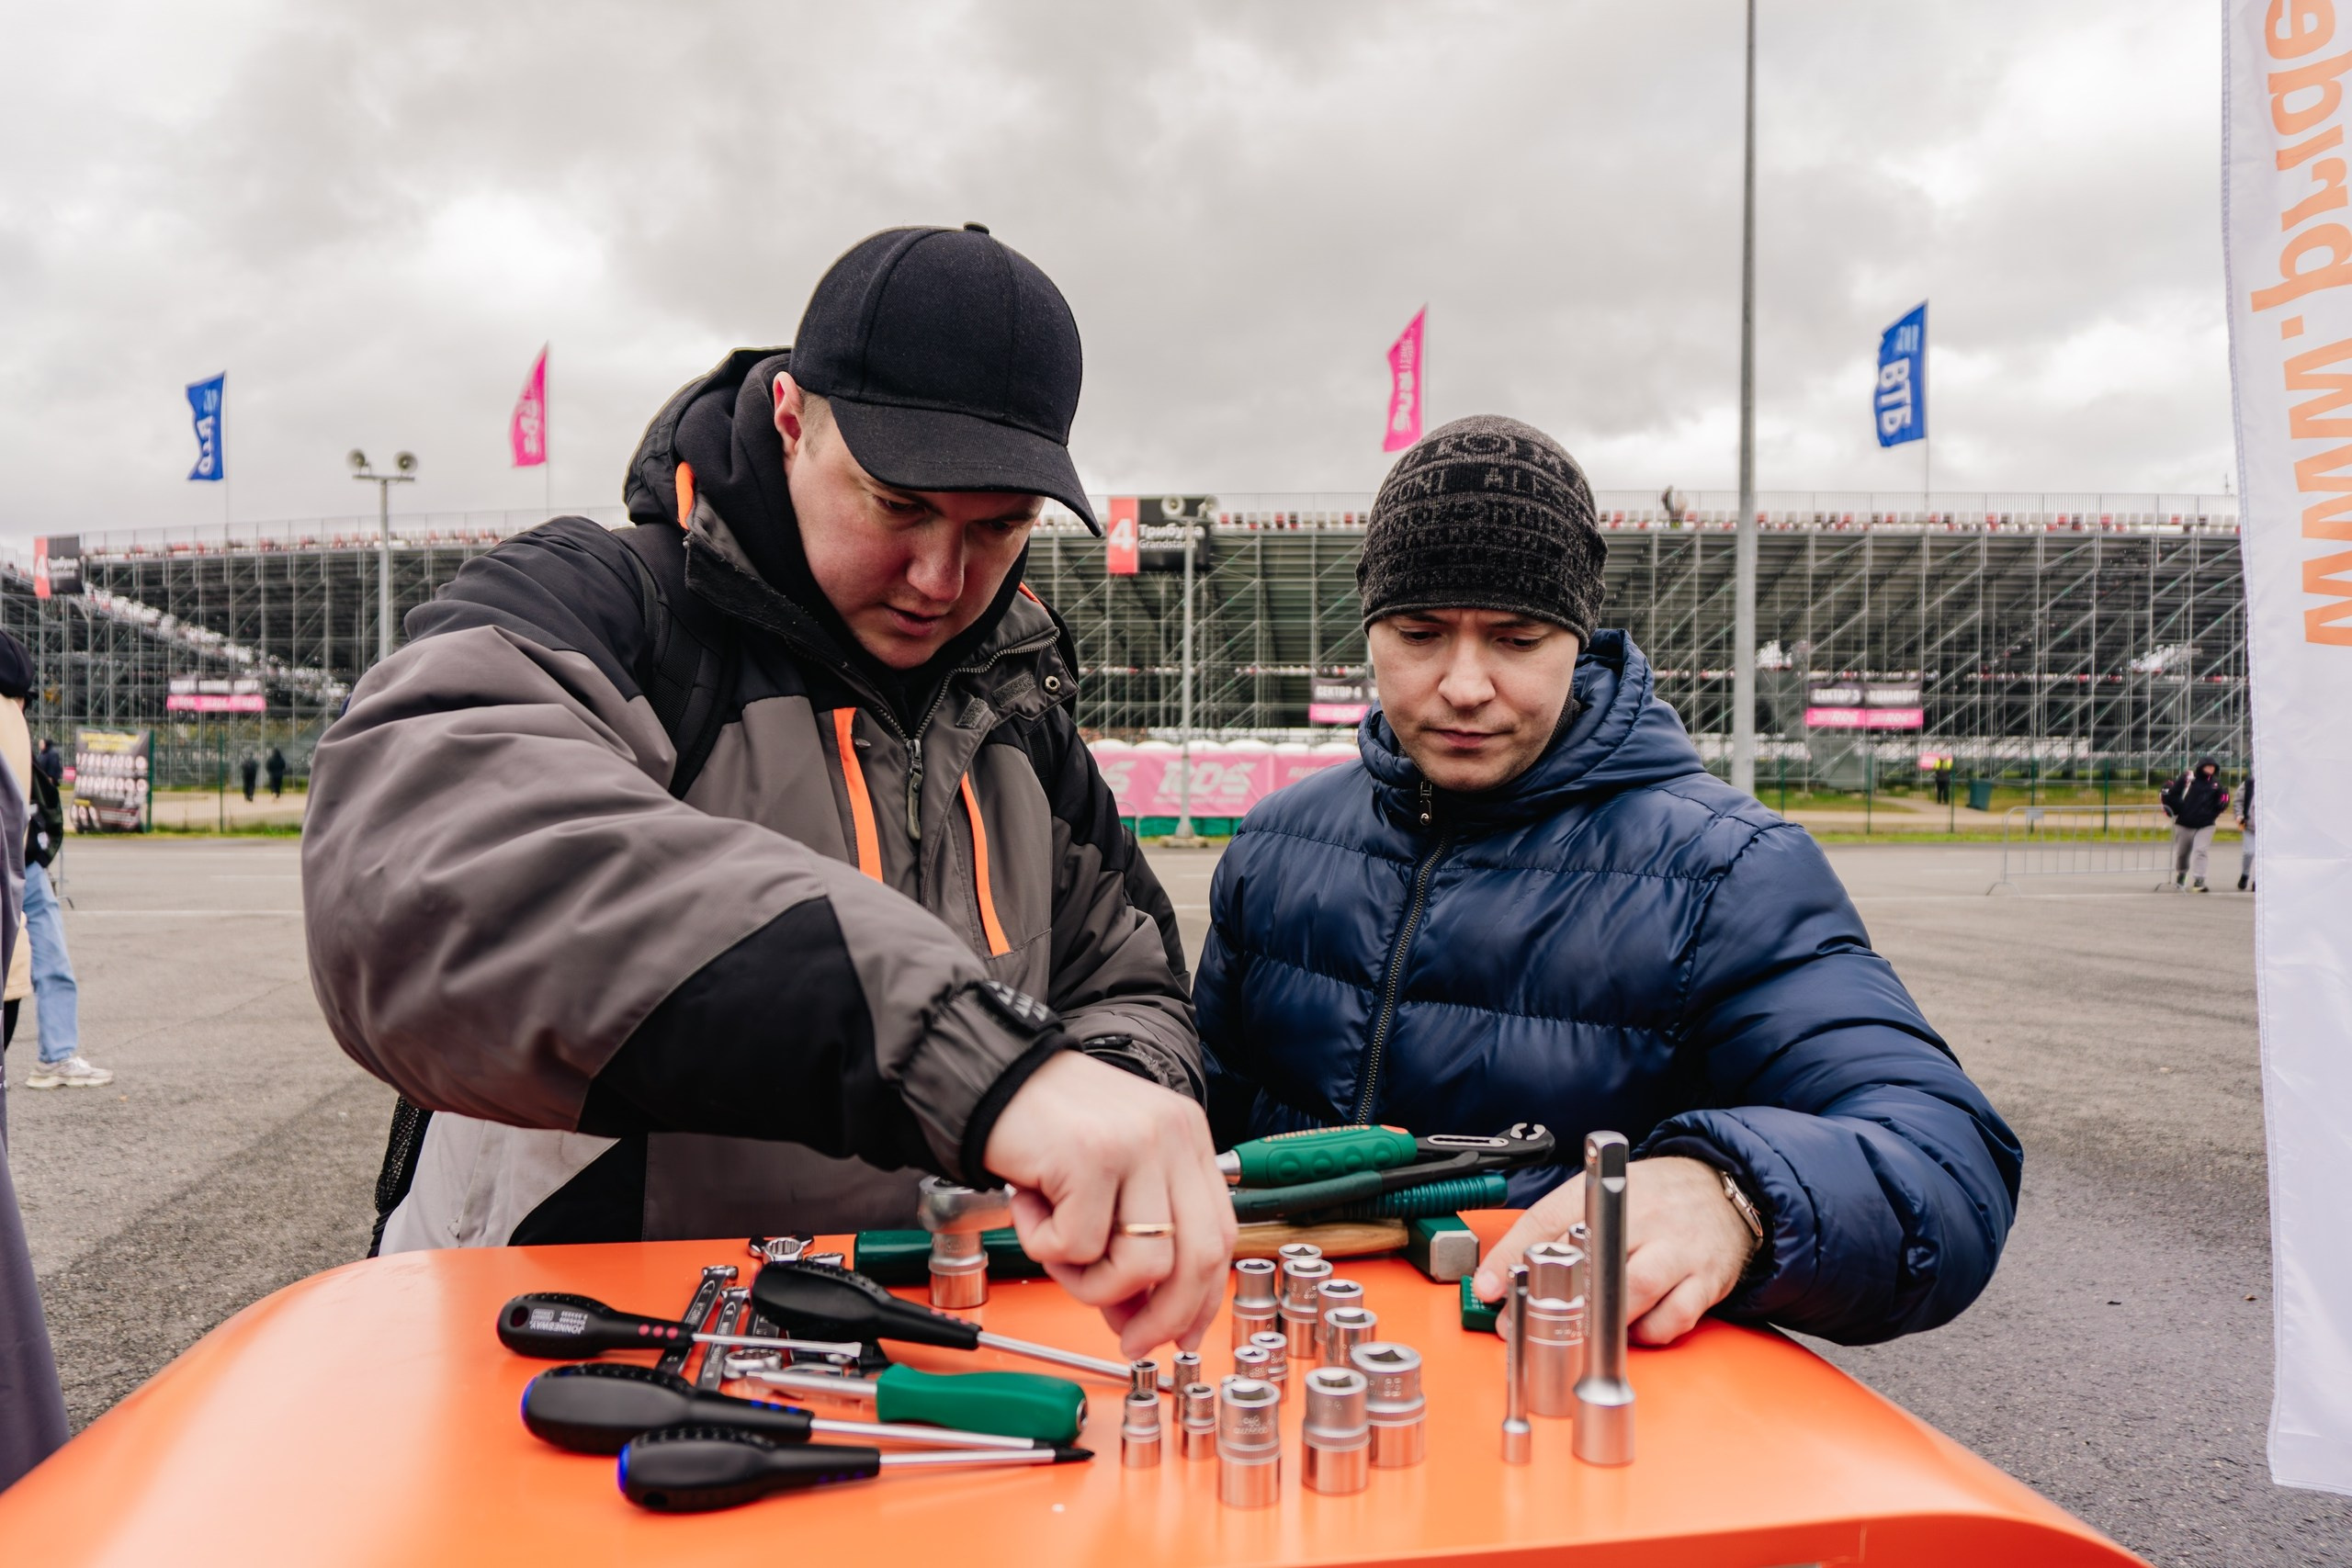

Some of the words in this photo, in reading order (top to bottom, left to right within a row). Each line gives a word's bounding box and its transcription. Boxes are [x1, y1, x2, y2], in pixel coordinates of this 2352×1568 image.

[1878, 357, 1912, 436] ВТБ
[1110, 518, 1136, 551] 4
[1138, 523, 1205, 539] Трибуа
[1139, 539, 1198, 549] Grandstad
[1868, 689, 1920, 703] КОМФОРТ
[1157, 761, 1257, 795] RDS
[529, 1320, 585, 1335] JONNESWAY
